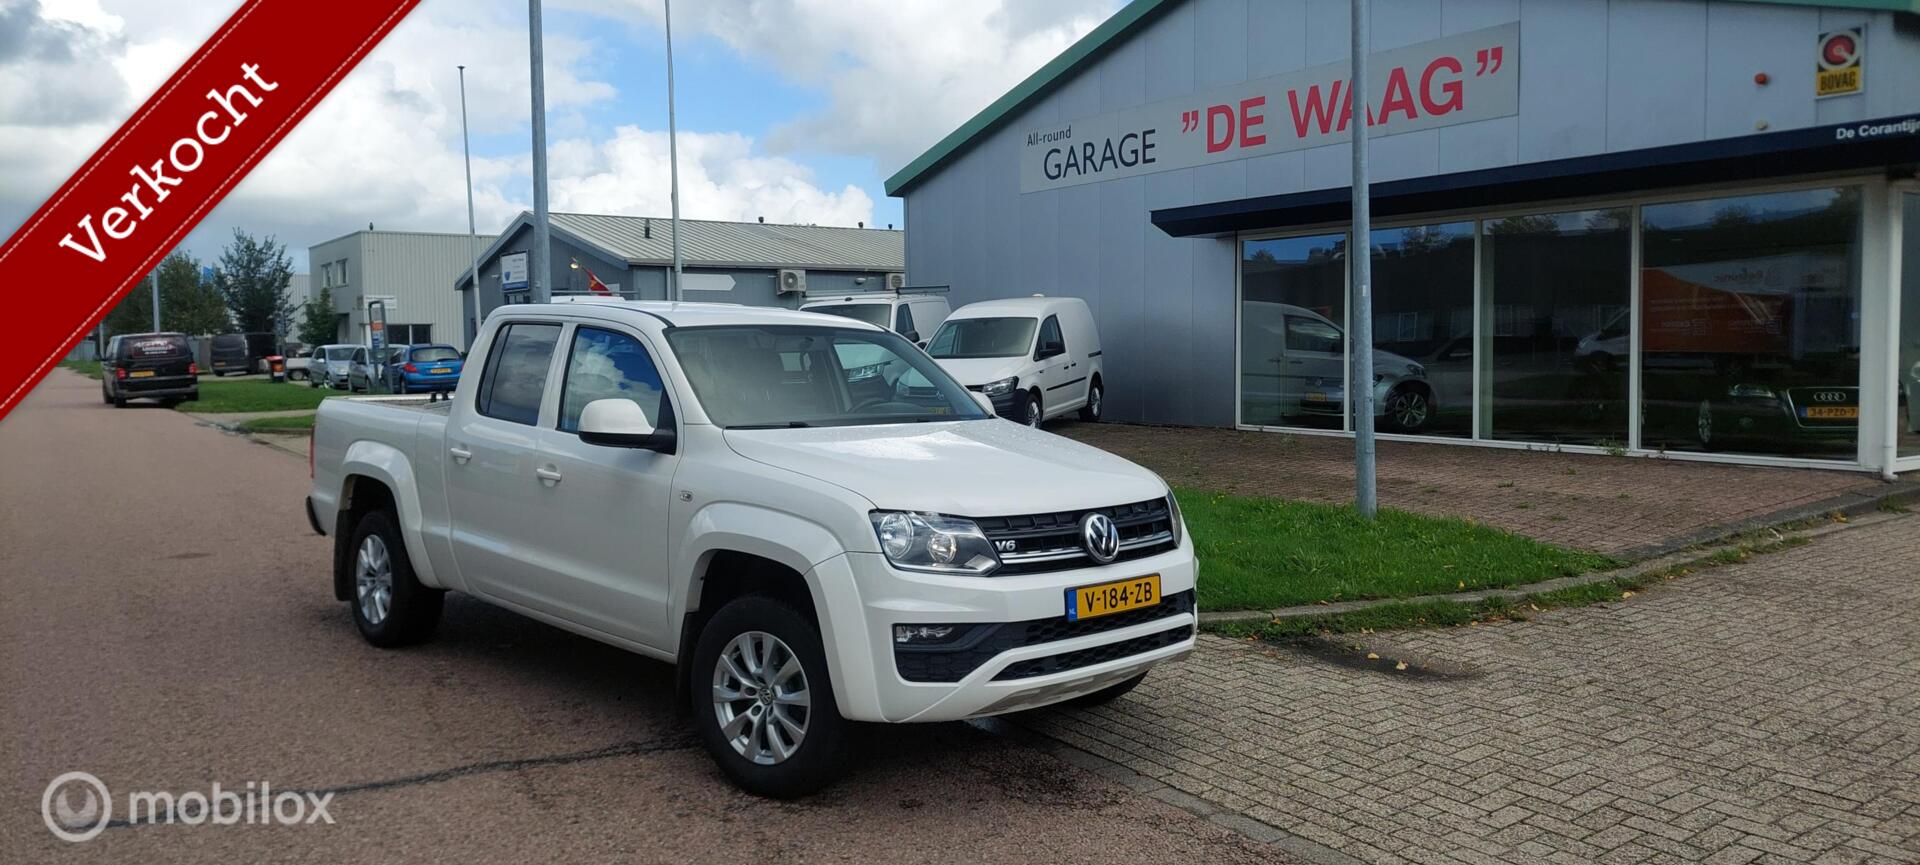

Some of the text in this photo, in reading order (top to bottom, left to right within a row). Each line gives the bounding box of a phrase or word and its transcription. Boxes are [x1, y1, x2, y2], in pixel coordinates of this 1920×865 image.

[1820, 70, 1857, 91] BOVAG
[1027, 125, 1072, 147] All-round
[1836, 127, 1856, 140] De
[1043, 129, 1157, 180] GARAGE
[995, 539, 1017, 552] V6
[1085, 581, 1153, 613] V-184-ZB
